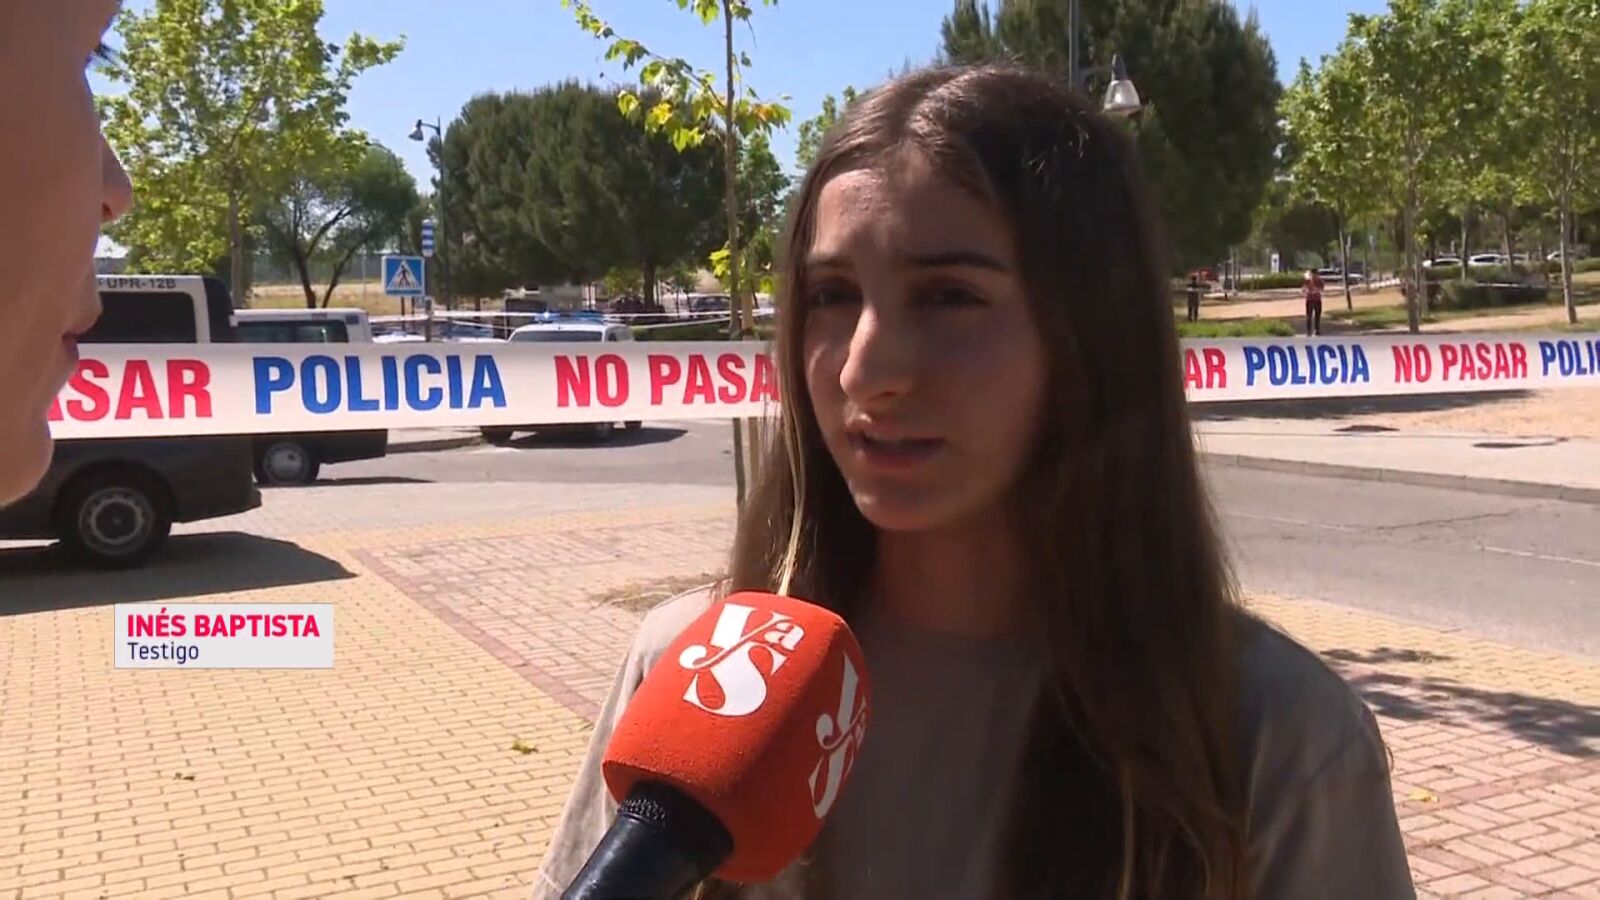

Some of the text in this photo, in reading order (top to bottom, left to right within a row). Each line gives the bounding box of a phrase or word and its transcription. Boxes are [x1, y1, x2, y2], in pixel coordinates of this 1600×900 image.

[47, 353, 781, 421] SAR POLICIA NO PASA
[1184, 347, 1227, 389] AR
[1243, 344, 1370, 387] POLICIA
[1393, 344, 1433, 384] NO
[1441, 342, 1528, 382] PASAR
